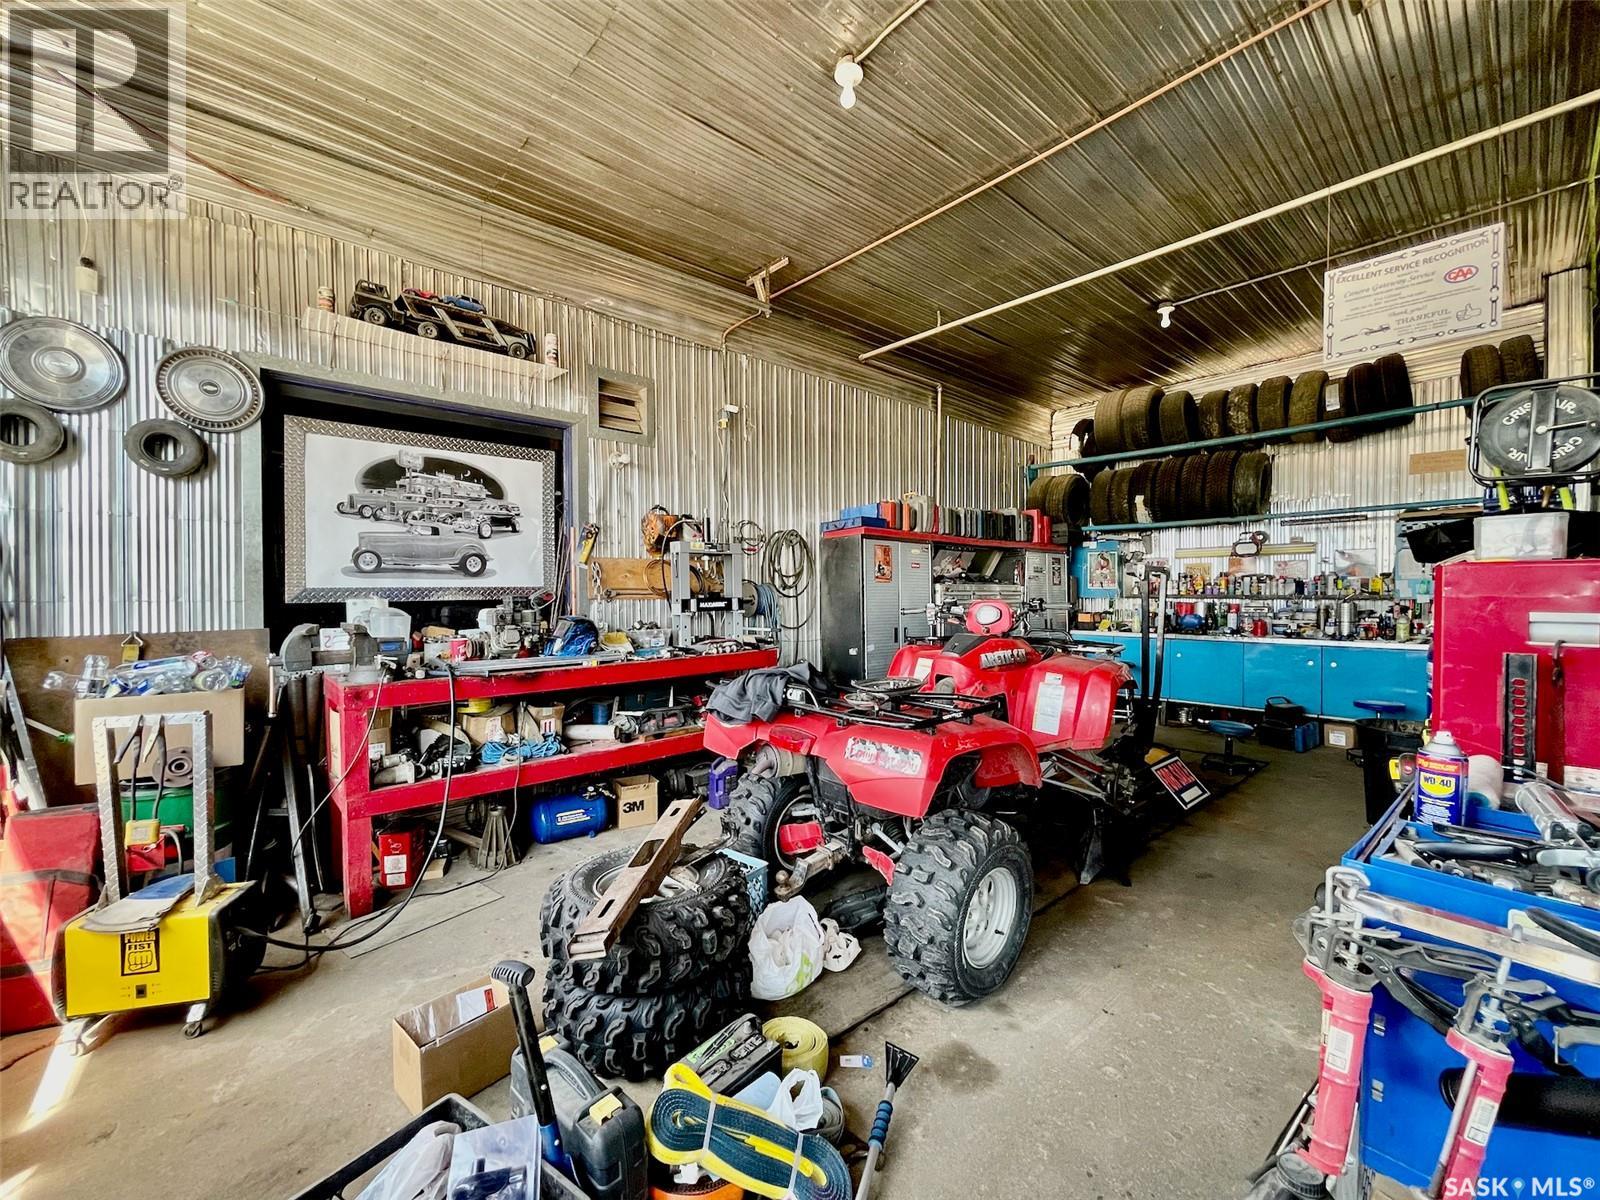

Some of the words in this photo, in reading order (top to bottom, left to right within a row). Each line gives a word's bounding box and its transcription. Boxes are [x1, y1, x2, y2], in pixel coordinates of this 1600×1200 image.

[1336, 269, 1383, 284] EXCELLENT
[1384, 258, 1420, 276] SERVICE
[1422, 237, 1489, 265] RECOGNITION
[1448, 267, 1474, 282] CAA
[1395, 308, 1451, 326] THANKFUL
[980, 650, 1014, 669] ARCTIC
[1424, 775, 1452, 788] WD-40
[622, 799, 645, 814] 3M
[124, 931, 156, 944] POWER
[127, 942, 152, 951] FIST
